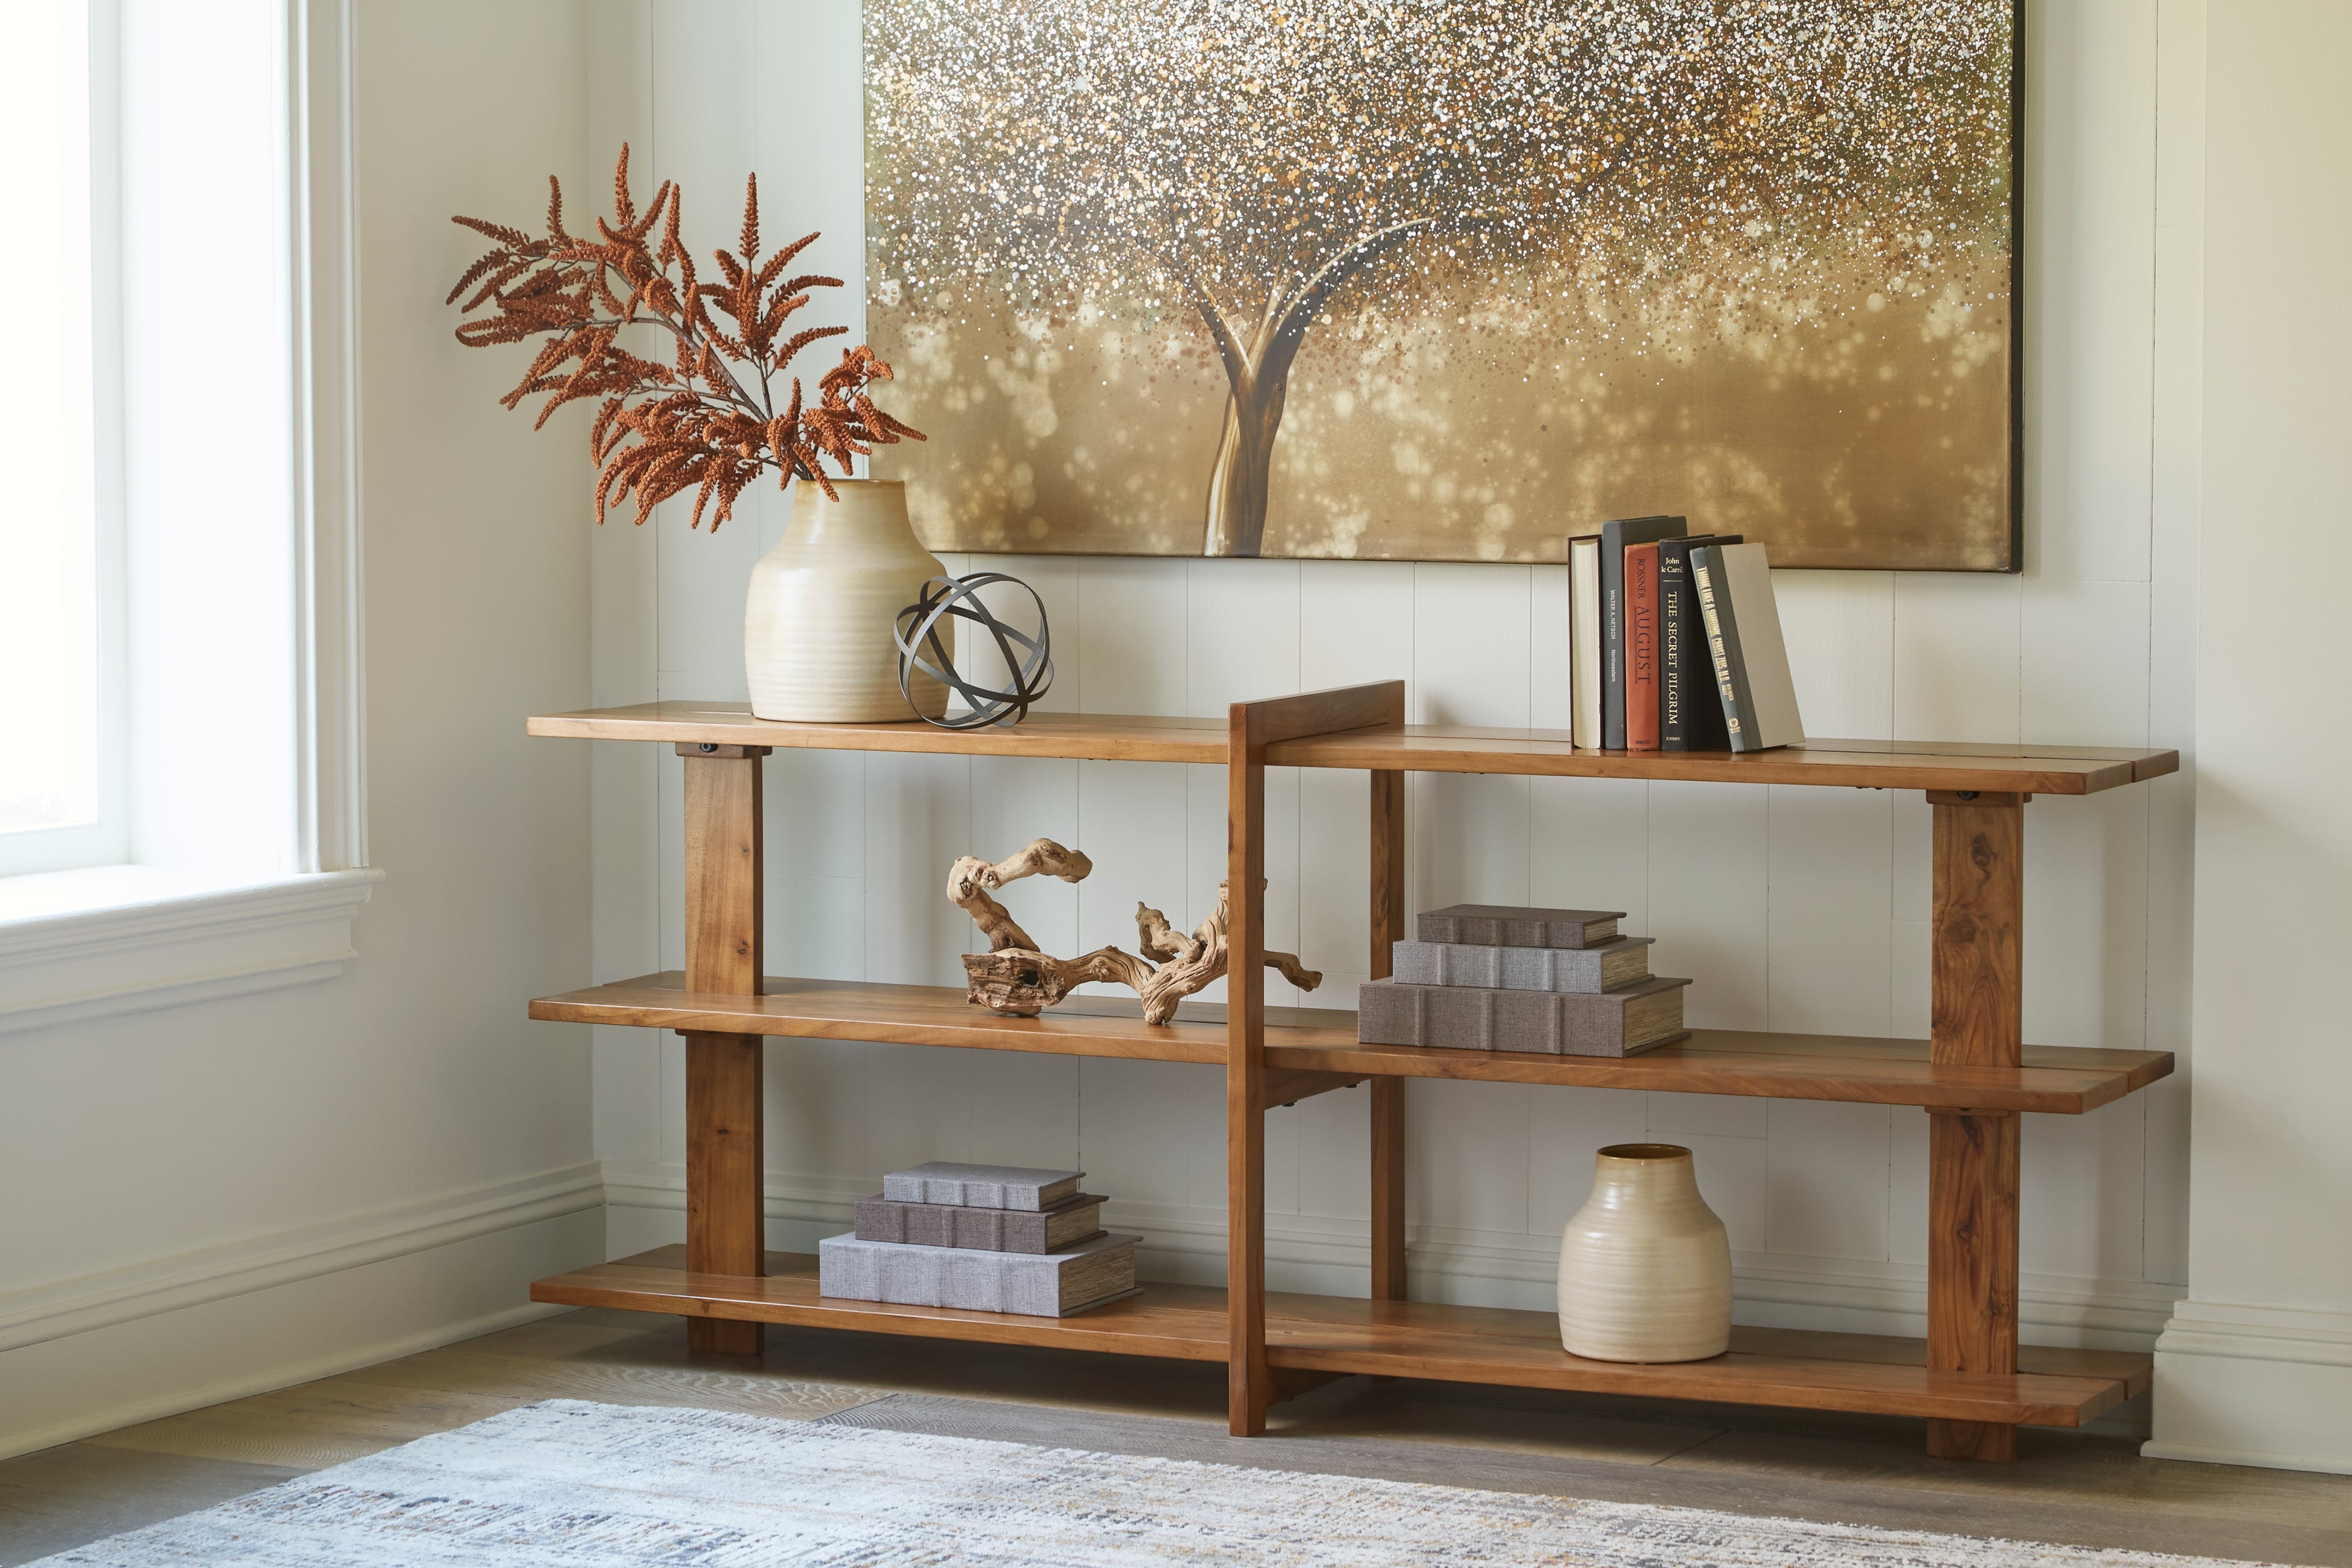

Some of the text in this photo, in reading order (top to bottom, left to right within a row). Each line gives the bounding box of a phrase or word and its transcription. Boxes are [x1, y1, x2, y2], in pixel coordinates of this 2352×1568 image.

[1637, 559, 1646, 599] ROSSNER
[1696, 566, 1711, 589] THINK
[1700, 588, 1714, 604] LIKE
[1705, 609, 1721, 637] SHRINK
[1638, 606, 1651, 684] AUGUST
[1668, 591, 1678, 724] THE SECRET PILGRIM
